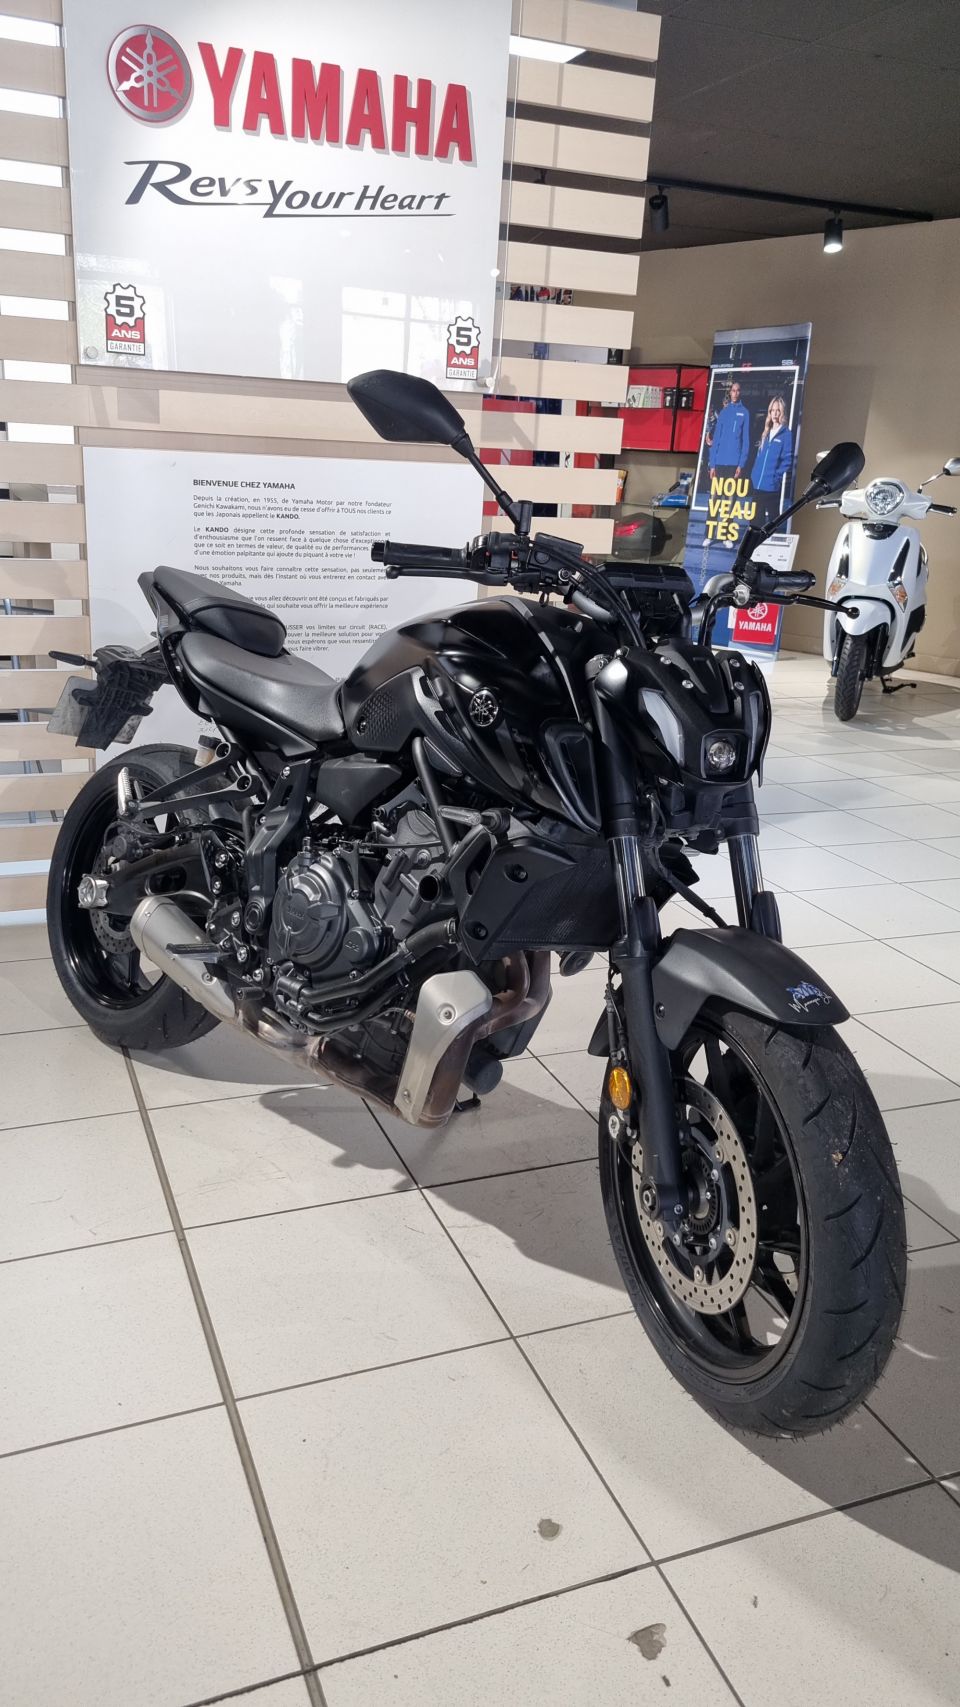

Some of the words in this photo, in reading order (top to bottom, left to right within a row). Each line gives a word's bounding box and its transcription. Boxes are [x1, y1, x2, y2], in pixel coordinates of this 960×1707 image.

[198, 42, 474, 162] YAMAHA
[123, 160, 263, 206] Revs
[263, 180, 356, 218] Your
[354, 185, 452, 211] Heart
[115, 295, 135, 318] 5
[111, 328, 141, 339] ANS
[456, 326, 473, 347] 5
[109, 341, 143, 353] GARANTIE
[450, 356, 475, 366] ANS
[448, 369, 475, 378] GARANTIE
[711, 477, 750, 497] NOU
[193, 495, 213, 503] Depuis
[216, 503, 246, 511] Kawakami,
[709, 499, 757, 521] VEAU
[216, 511, 240, 519] Japonais
[242, 512, 268, 520] appellent
[234, 527, 255, 535] désigne
[279, 528, 305, 536] profonde
[706, 518, 740, 542] TÉS
[309, 536, 331, 544] quelque
[332, 544, 368, 552] performances
[739, 620, 772, 632] YAMAHA
